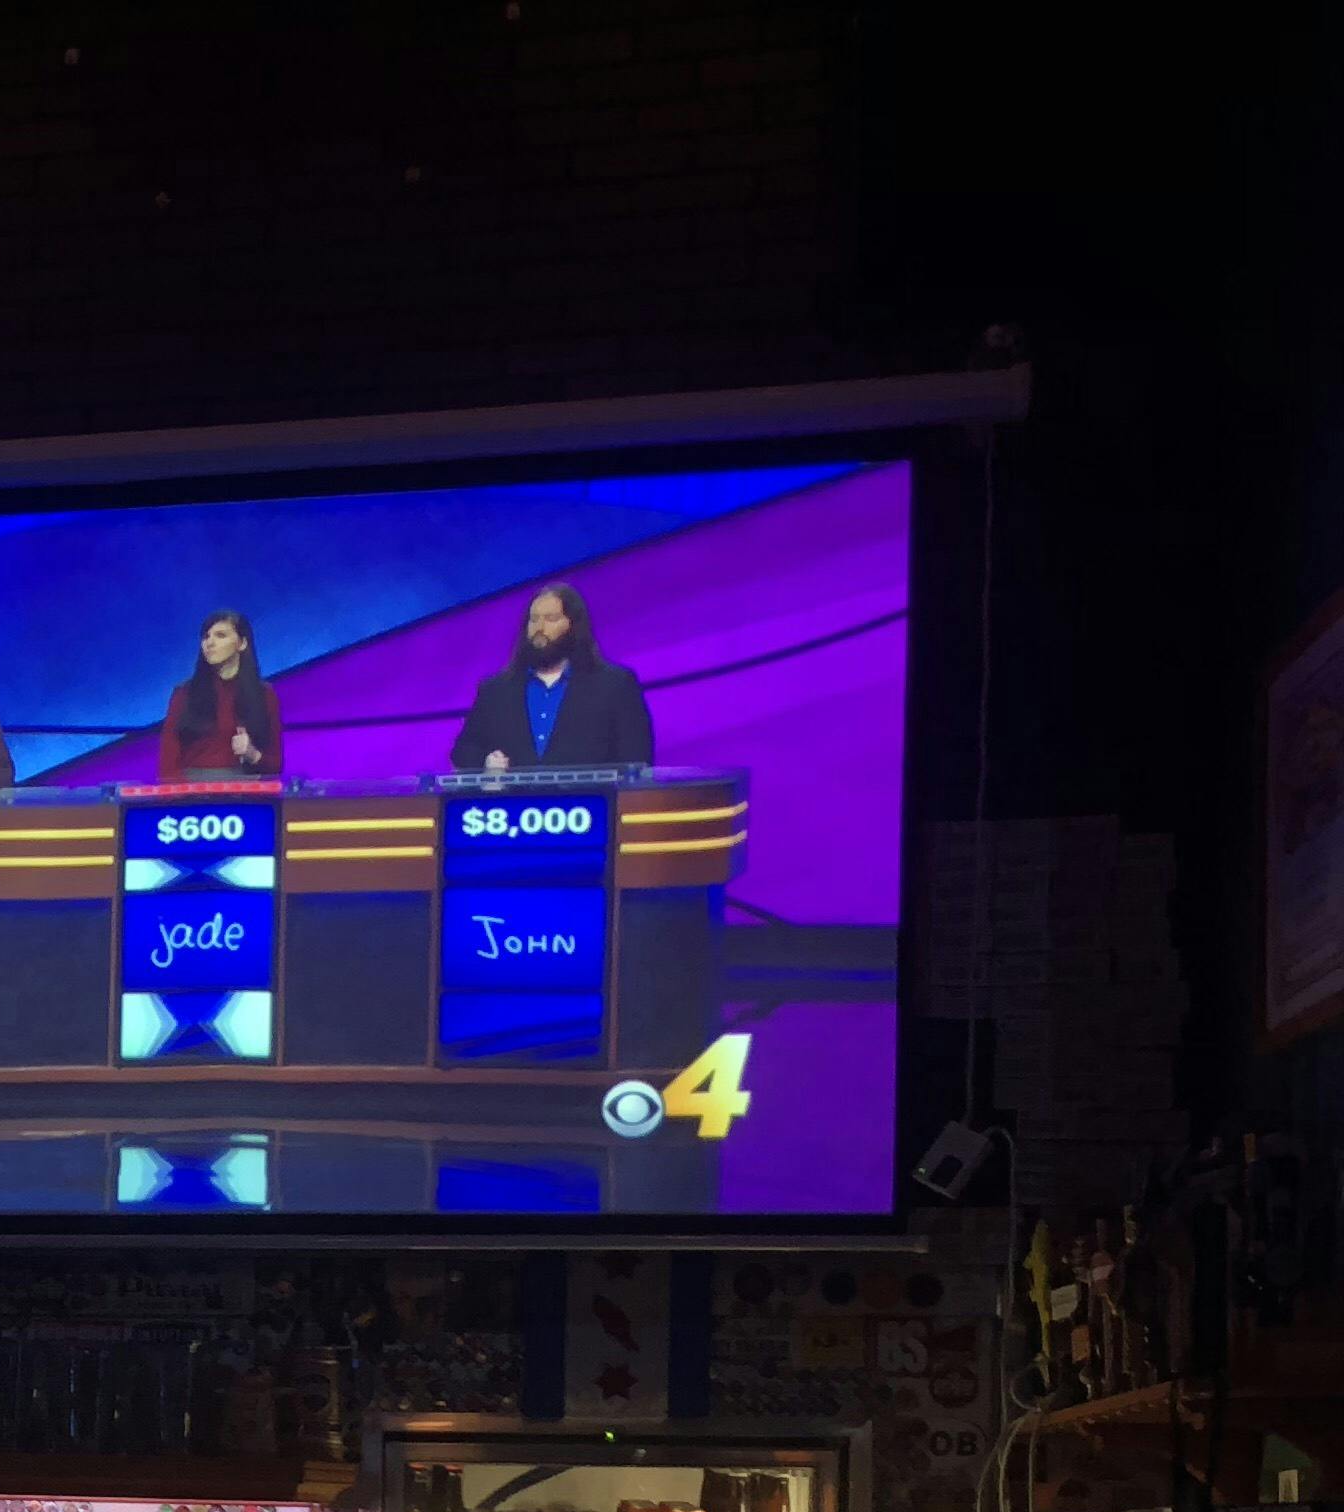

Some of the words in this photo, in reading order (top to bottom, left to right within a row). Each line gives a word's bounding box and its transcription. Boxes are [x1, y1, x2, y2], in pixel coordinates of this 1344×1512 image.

[156, 813, 246, 845] $600
[462, 806, 592, 839] $8,000
[151, 913, 247, 968] jade
[661, 1032, 753, 1139] 4
